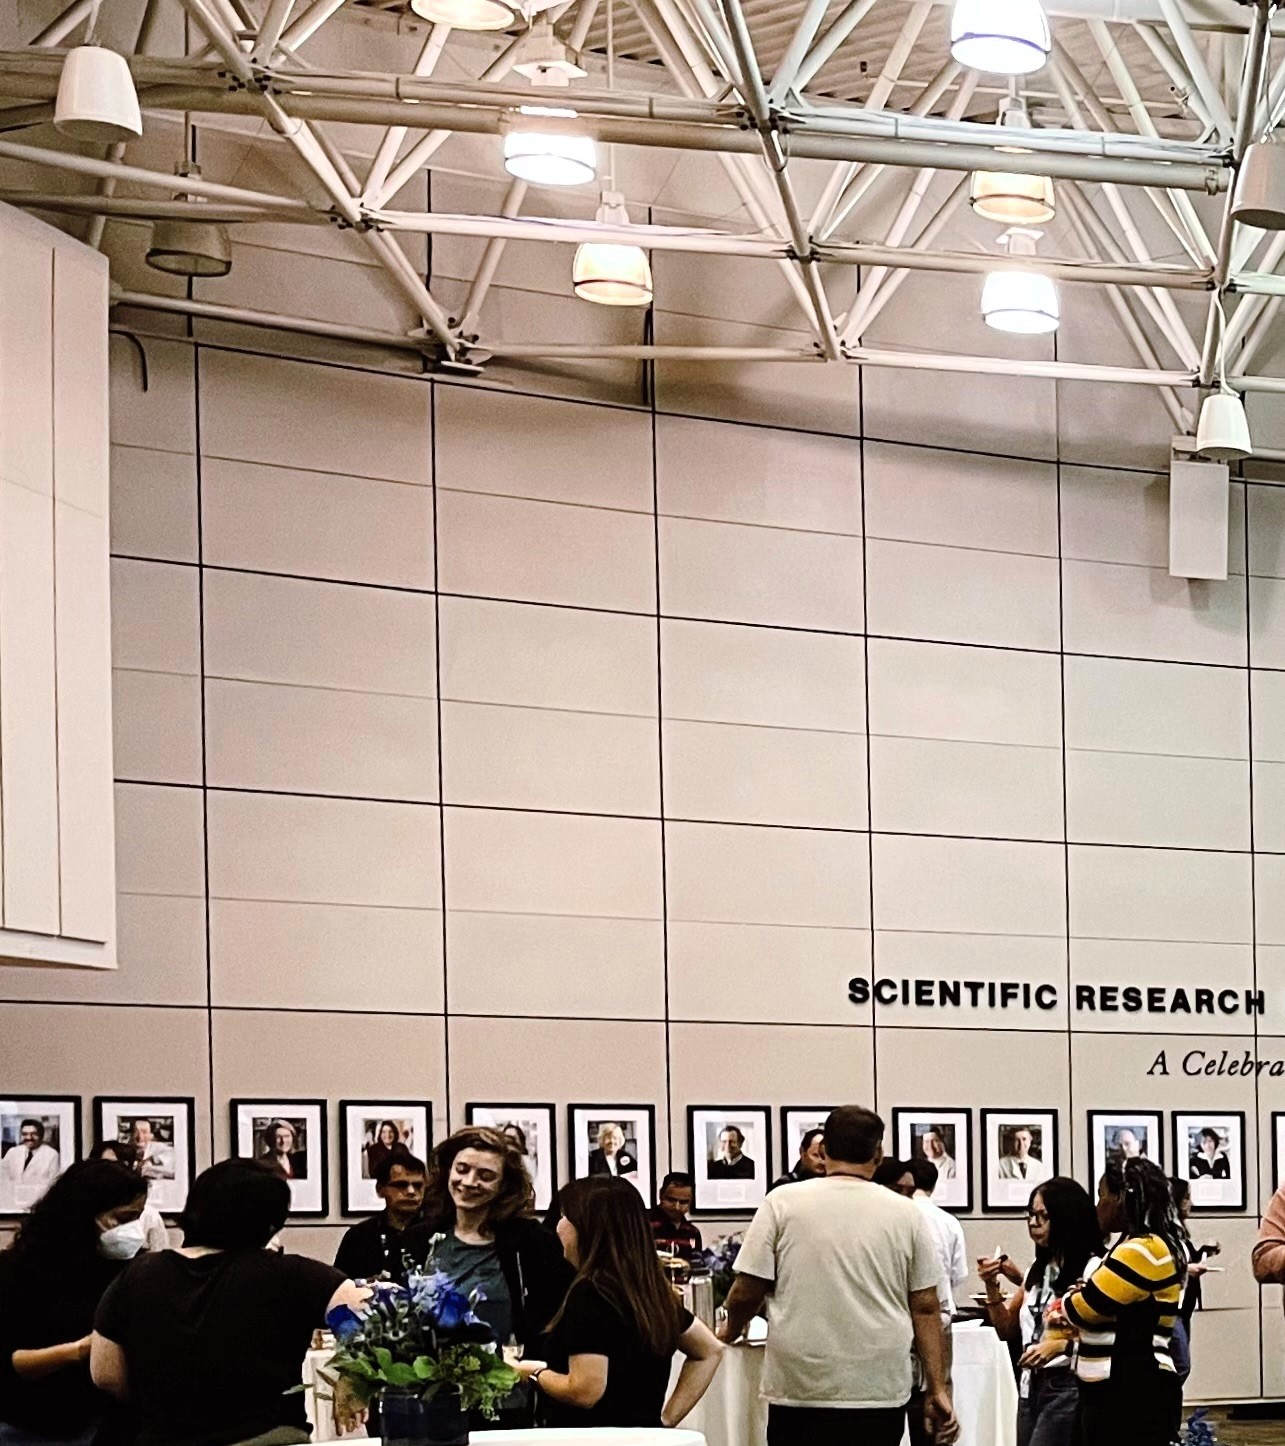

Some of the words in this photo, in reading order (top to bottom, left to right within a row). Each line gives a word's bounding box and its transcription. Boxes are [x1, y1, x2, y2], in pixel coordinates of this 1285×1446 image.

[848, 977, 1058, 1010] SCIENTIFIC
[1075, 984, 1265, 1015] RESEARCH
[1146, 1050, 1170, 1075] A
